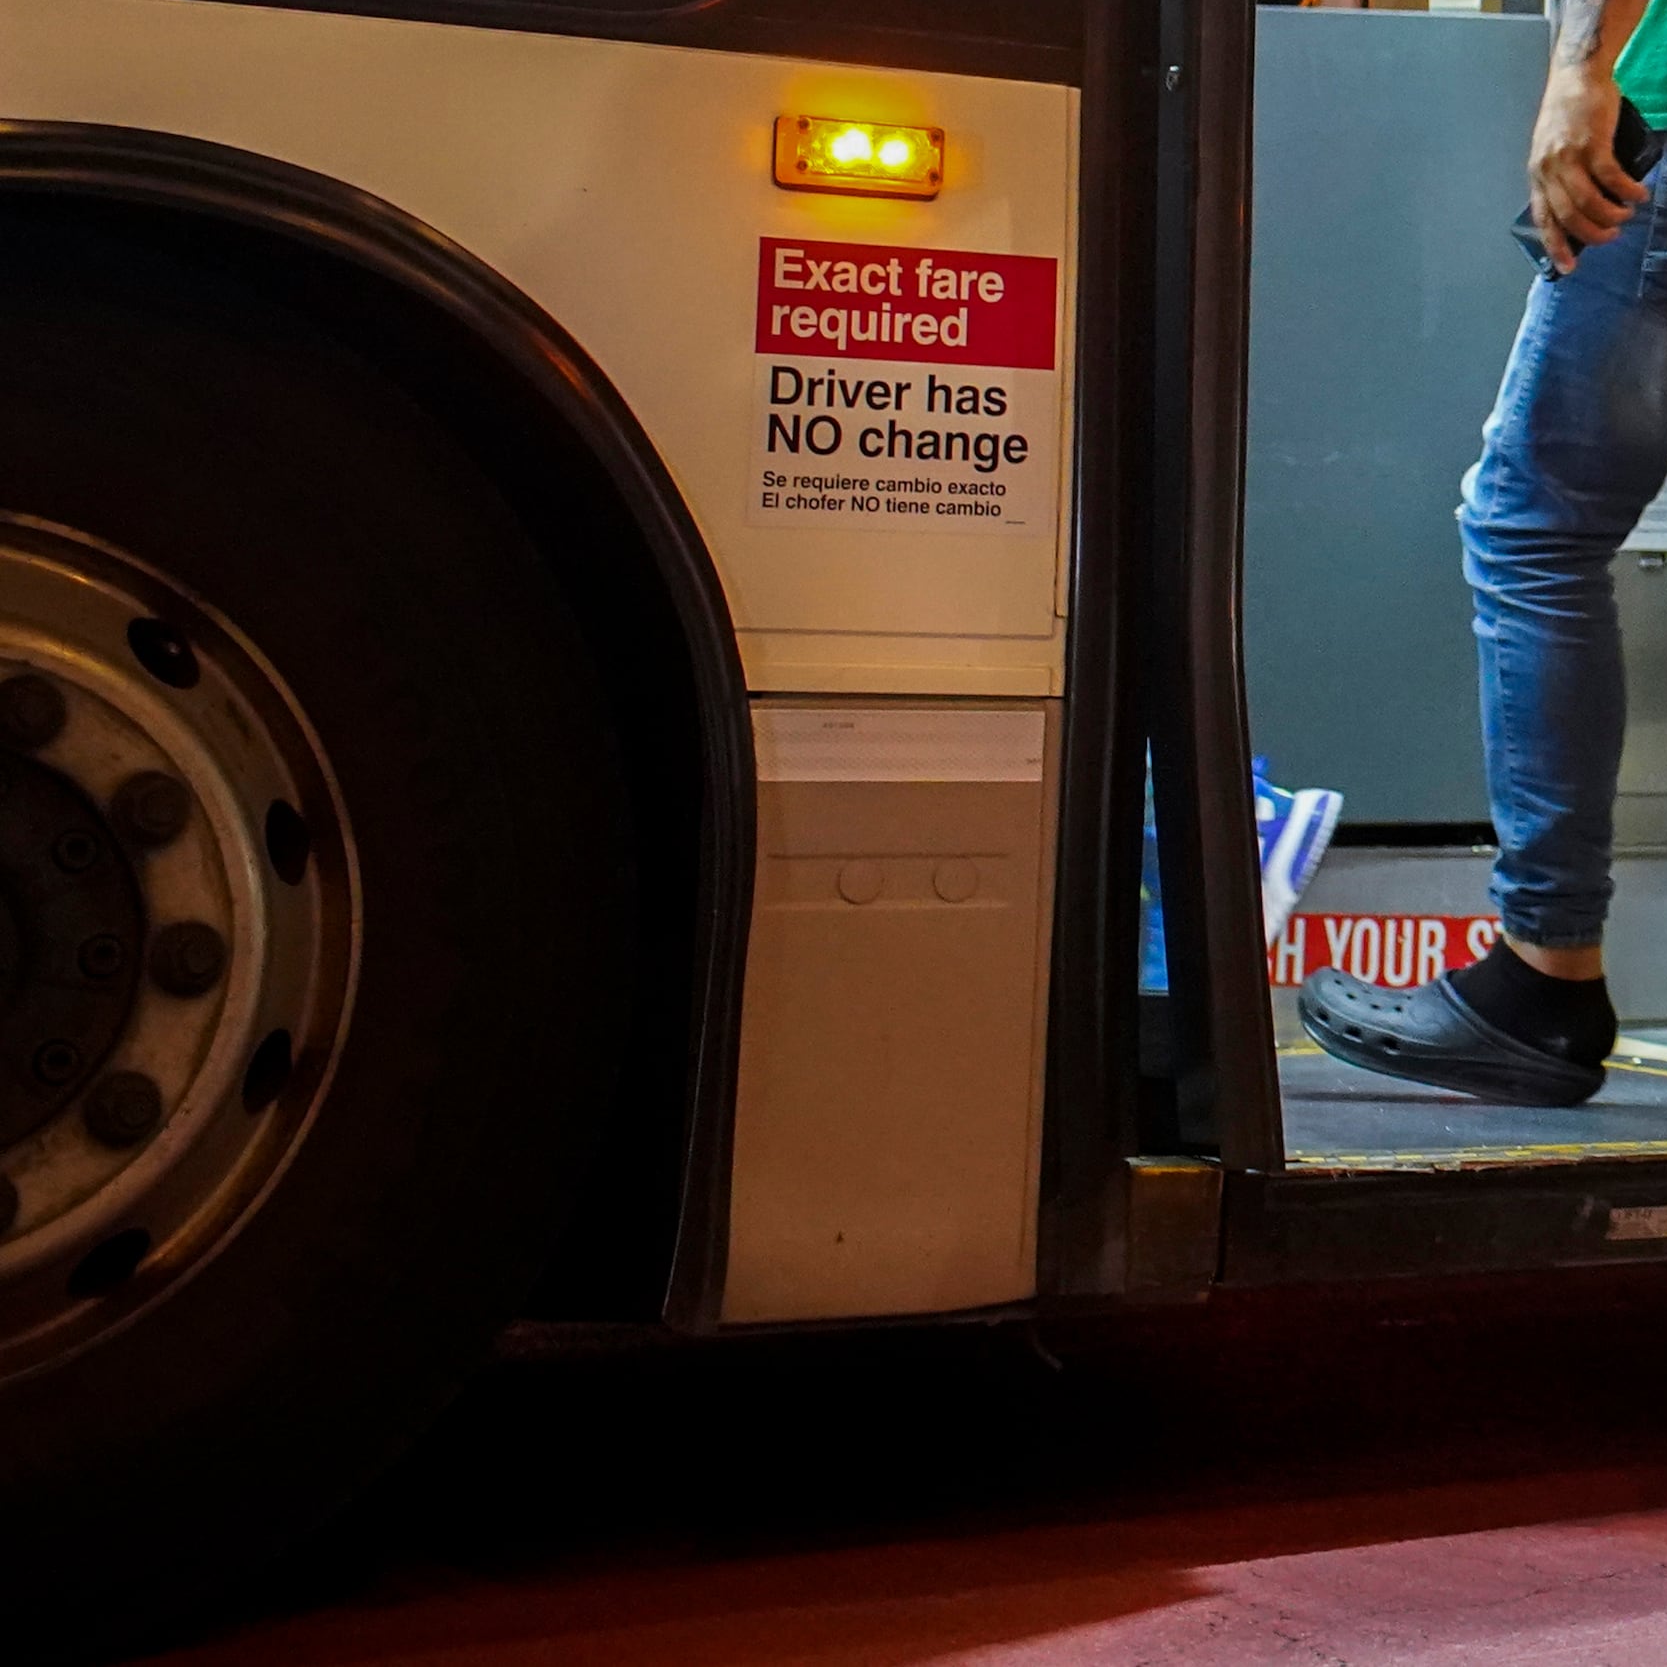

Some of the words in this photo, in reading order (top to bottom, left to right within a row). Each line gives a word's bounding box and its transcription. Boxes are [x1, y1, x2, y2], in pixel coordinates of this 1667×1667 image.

[774, 247, 903, 296] Exact
[915, 258, 1005, 304] fare
[771, 301, 968, 351] required
[769, 365, 912, 412] Driver
[926, 374, 1008, 417] has
[767, 413, 842, 456] NO
[858, 419, 1029, 473] change
[761, 492, 780, 509] El
[785, 494, 846, 512] chofer
[850, 496, 881, 513] NO
[885, 497, 931, 515] tiene
[935, 500, 1002, 517] cambio
[762, 470, 788, 488] Se
[793, 473, 870, 493] requiere
[875, 477, 943, 495] cambio
[947, 481, 1007, 497] exacto
[1323, 916, 1447, 987] YOUR
